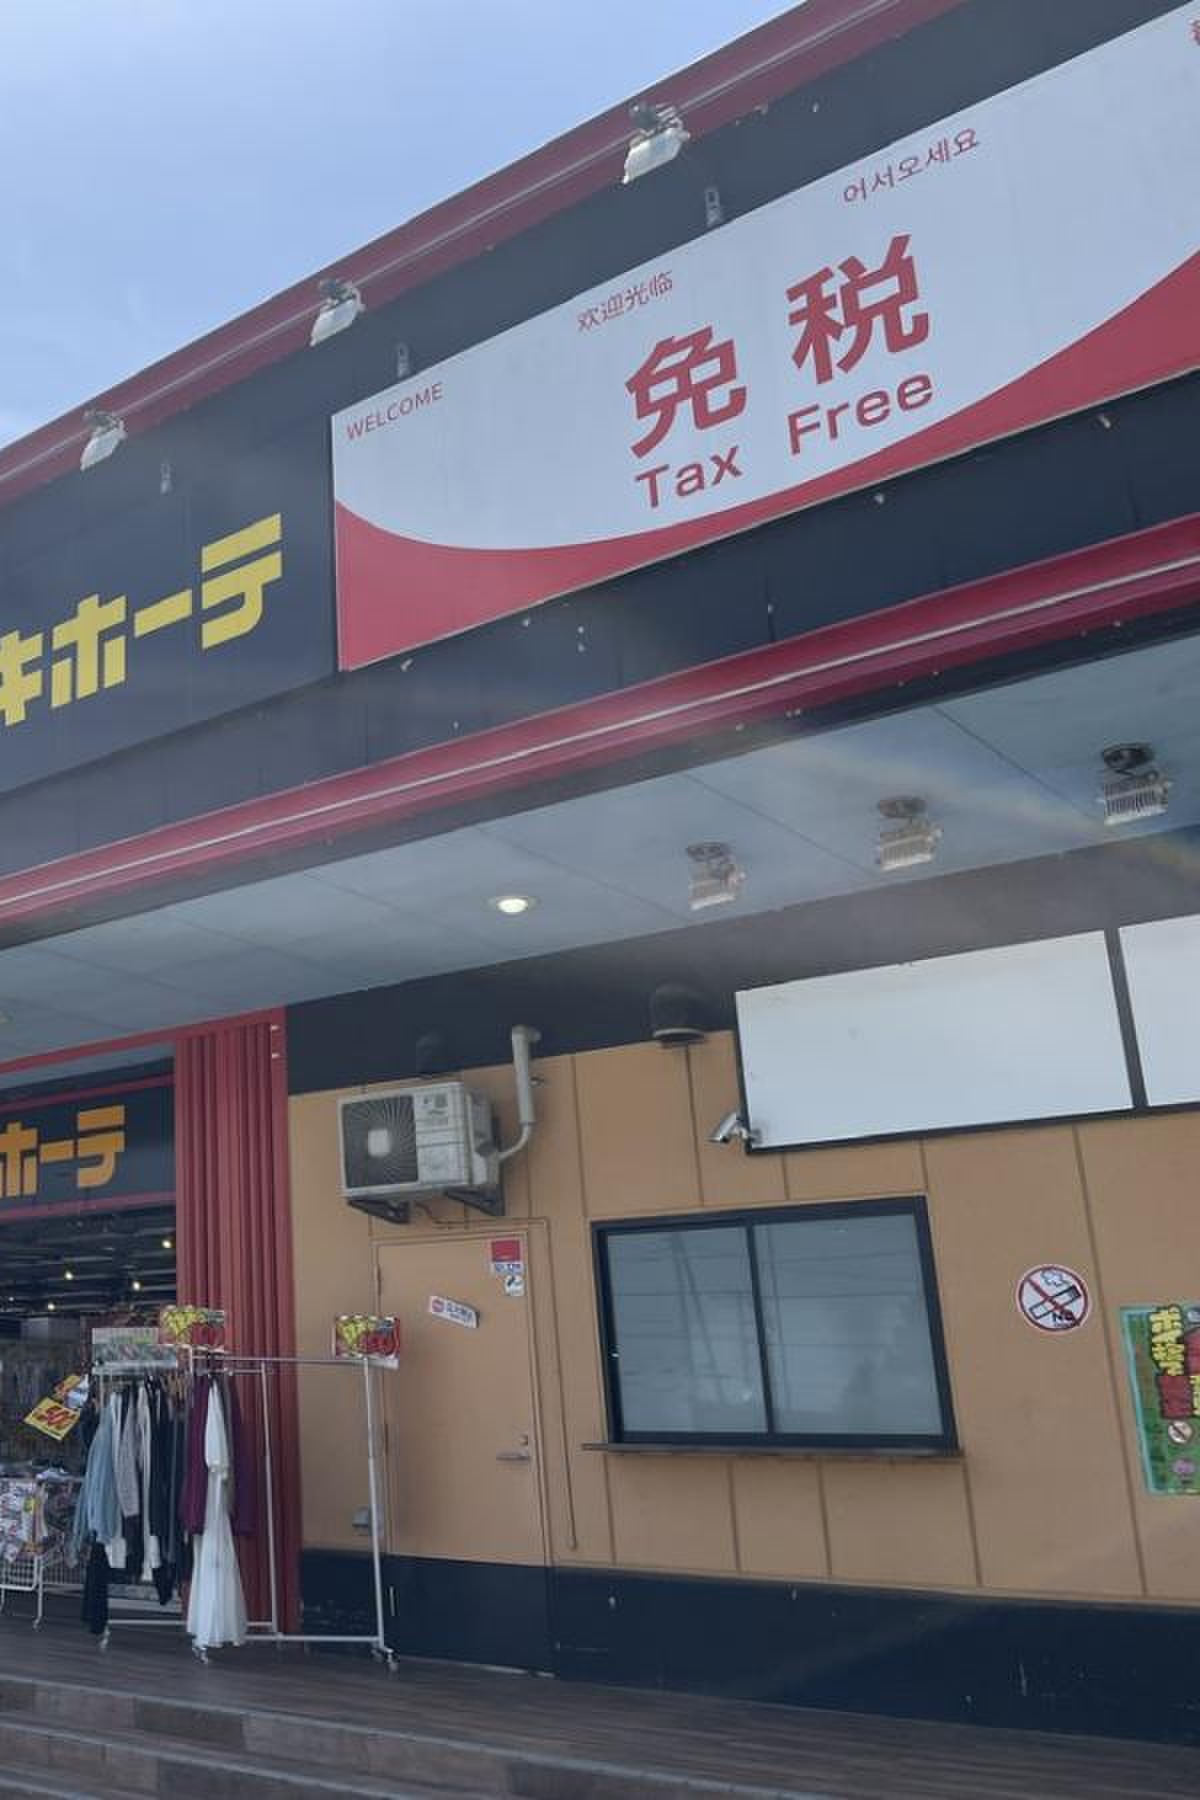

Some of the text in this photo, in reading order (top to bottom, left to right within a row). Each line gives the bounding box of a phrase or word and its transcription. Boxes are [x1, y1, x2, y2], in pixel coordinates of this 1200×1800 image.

[843, 127, 980, 203] 어서오세요
[577, 271, 673, 332] 欢迎光临
[346, 381, 444, 441] WELCOME
[635, 368, 934, 508] Tax Free
